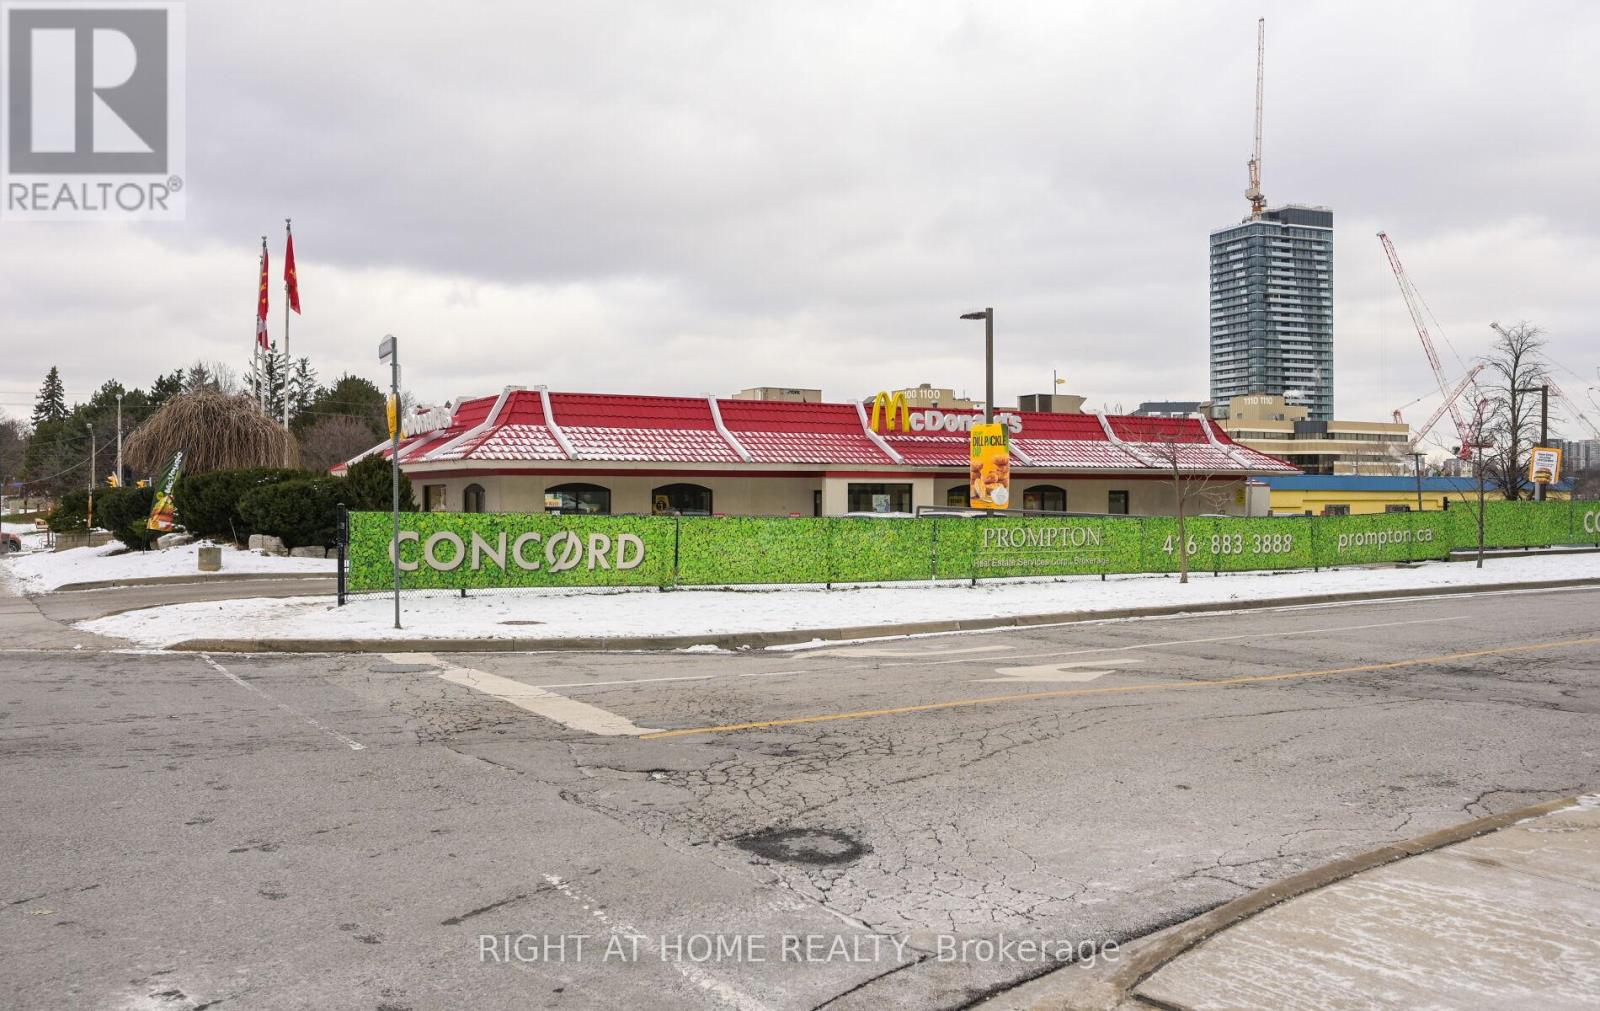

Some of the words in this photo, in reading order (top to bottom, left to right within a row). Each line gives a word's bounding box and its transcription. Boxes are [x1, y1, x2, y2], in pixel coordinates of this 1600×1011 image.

[919, 388, 941, 400] 1100
[982, 526, 1102, 548] PROMPTON
[1211, 534, 1243, 555] 883
[1253, 533, 1293, 554] 3888
[1337, 527, 1433, 553] prompton.ca
[1018, 557, 1049, 567] Services
